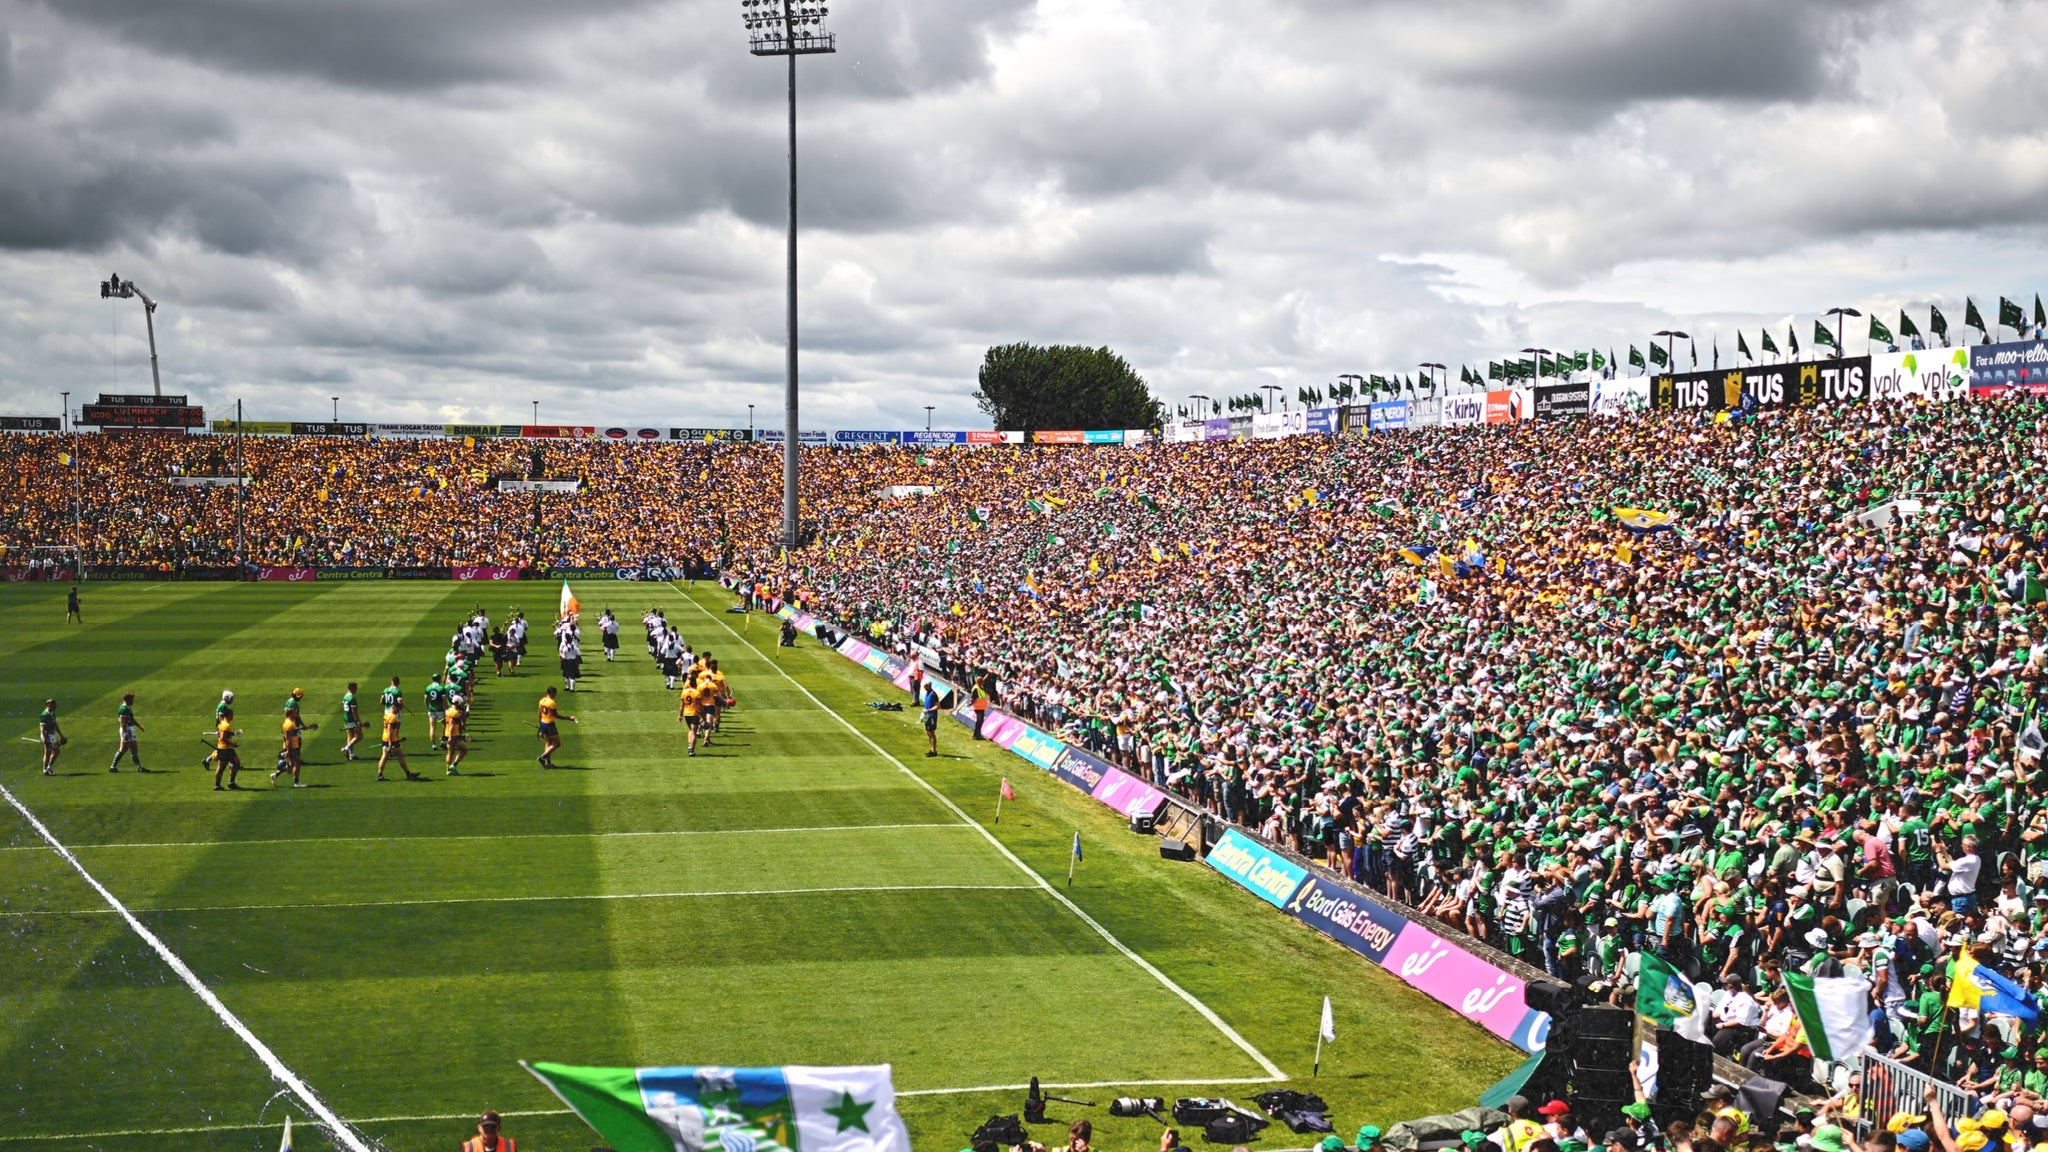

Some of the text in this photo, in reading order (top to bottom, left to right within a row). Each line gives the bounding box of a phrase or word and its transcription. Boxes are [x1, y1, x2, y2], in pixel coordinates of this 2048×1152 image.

[1976, 356, 1987, 366] For
[1988, 357, 1994, 365] a
[1821, 366, 1864, 400] TUS
[1873, 367, 1901, 394] vpk
[1921, 364, 1951, 391] vpk
[1675, 379, 1709, 408] TUS
[1746, 373, 1784, 404] TUS
[1454, 398, 1482, 421] kirby
[23, 419, 42, 428] TUS
[306, 425, 326, 433] TUS
[343, 425, 363, 433] TUS
[811, 430, 827, 438] Foods
[836, 431, 888, 440] CRESCENT
[316, 570, 383, 580] Centra Centra
[459, 567, 478, 580] eir
[492, 567, 512, 580] eir
[583, 570, 615, 580] Centra
[384, 693, 394, 704] 10
[429, 690, 438, 701] 9
[1913, 828, 1930, 847] 15
[1209, 834, 1297, 900] Centra Centra
[1306, 888, 1337, 919] Bord
[1350, 909, 1395, 952] Energy
[1400, 938, 1449, 977] eir
[1462, 973, 1517, 1014] eir
